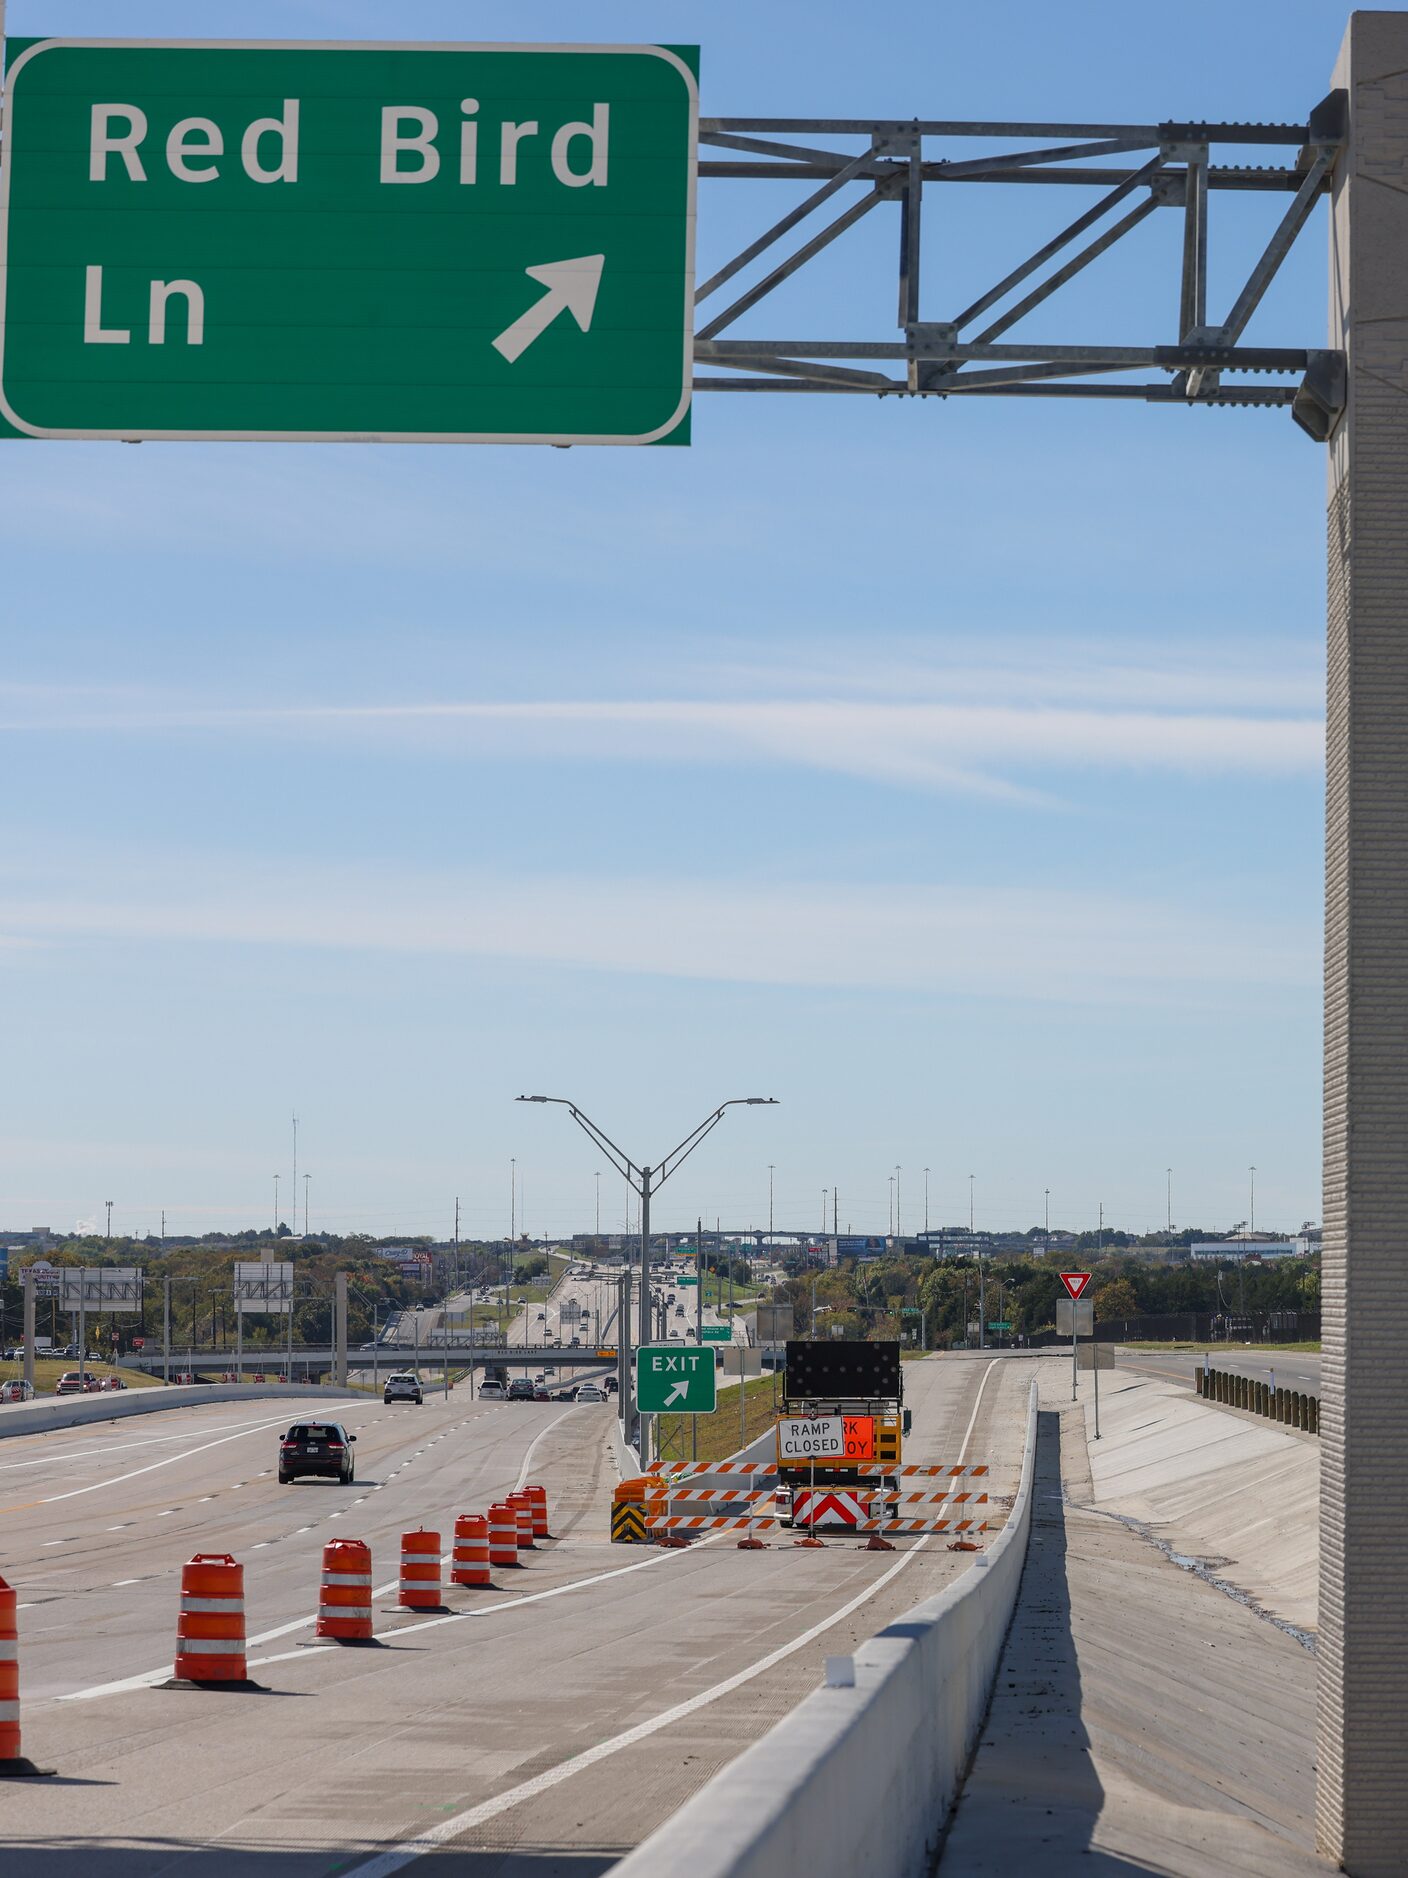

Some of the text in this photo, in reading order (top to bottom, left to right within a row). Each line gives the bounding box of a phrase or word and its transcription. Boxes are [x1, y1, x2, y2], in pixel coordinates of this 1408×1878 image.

[88, 97, 611, 188] Red Bird
[83, 264, 206, 346] Ln
[652, 1356, 700, 1372] EXIT
[791, 1422, 830, 1436] RAMP
[785, 1438, 839, 1454] CLOSED
